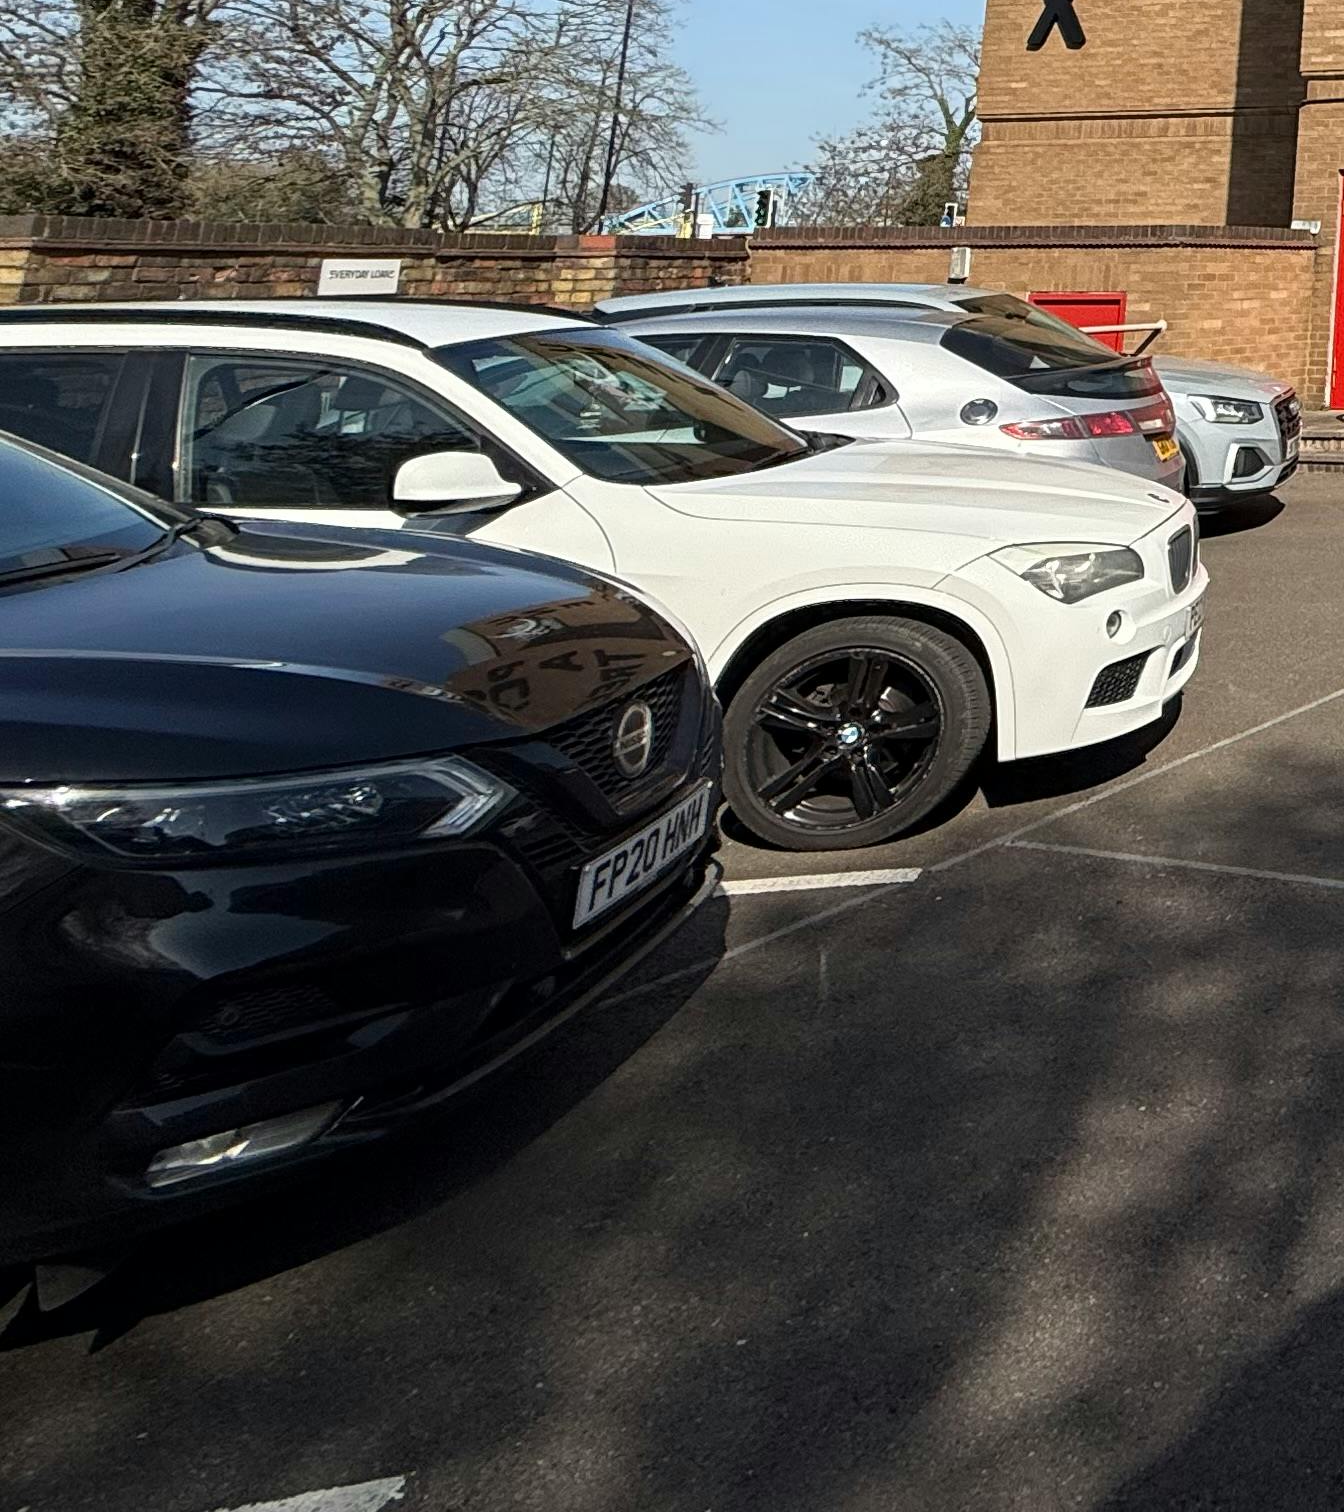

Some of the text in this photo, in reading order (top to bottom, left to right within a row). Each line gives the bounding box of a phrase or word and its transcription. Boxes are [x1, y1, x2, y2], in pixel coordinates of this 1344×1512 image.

[328, 269, 369, 280] EVERYDAY
[588, 792, 704, 913] FP20 HNH
